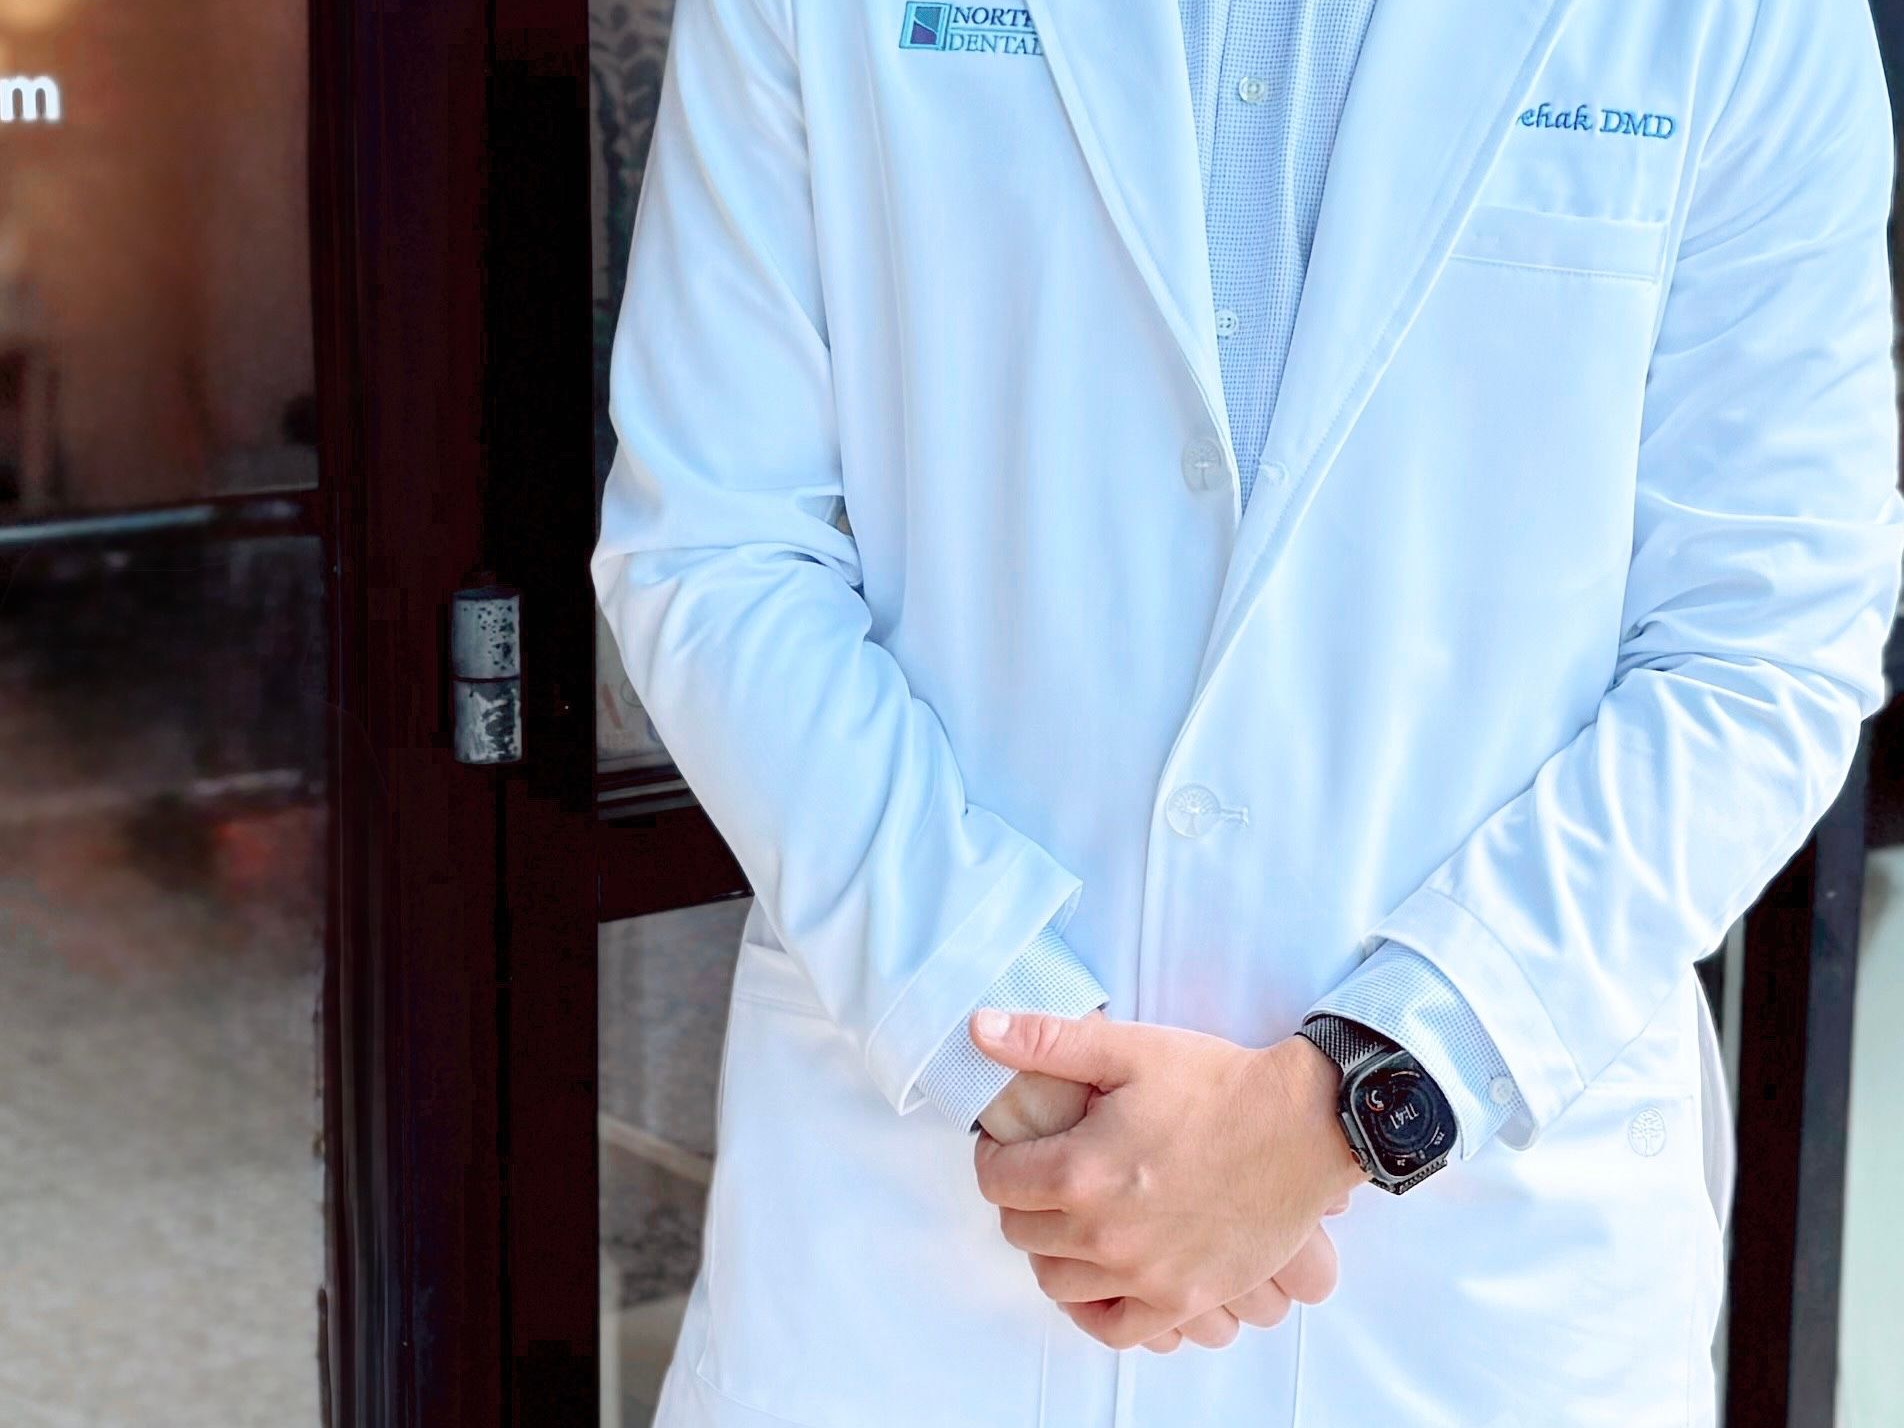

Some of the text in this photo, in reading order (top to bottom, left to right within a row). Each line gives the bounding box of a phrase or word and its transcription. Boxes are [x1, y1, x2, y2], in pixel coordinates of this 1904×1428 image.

[949, 33, 1043, 56] DENTAL
[1516, 102, 1676, 139] ehak DMD
